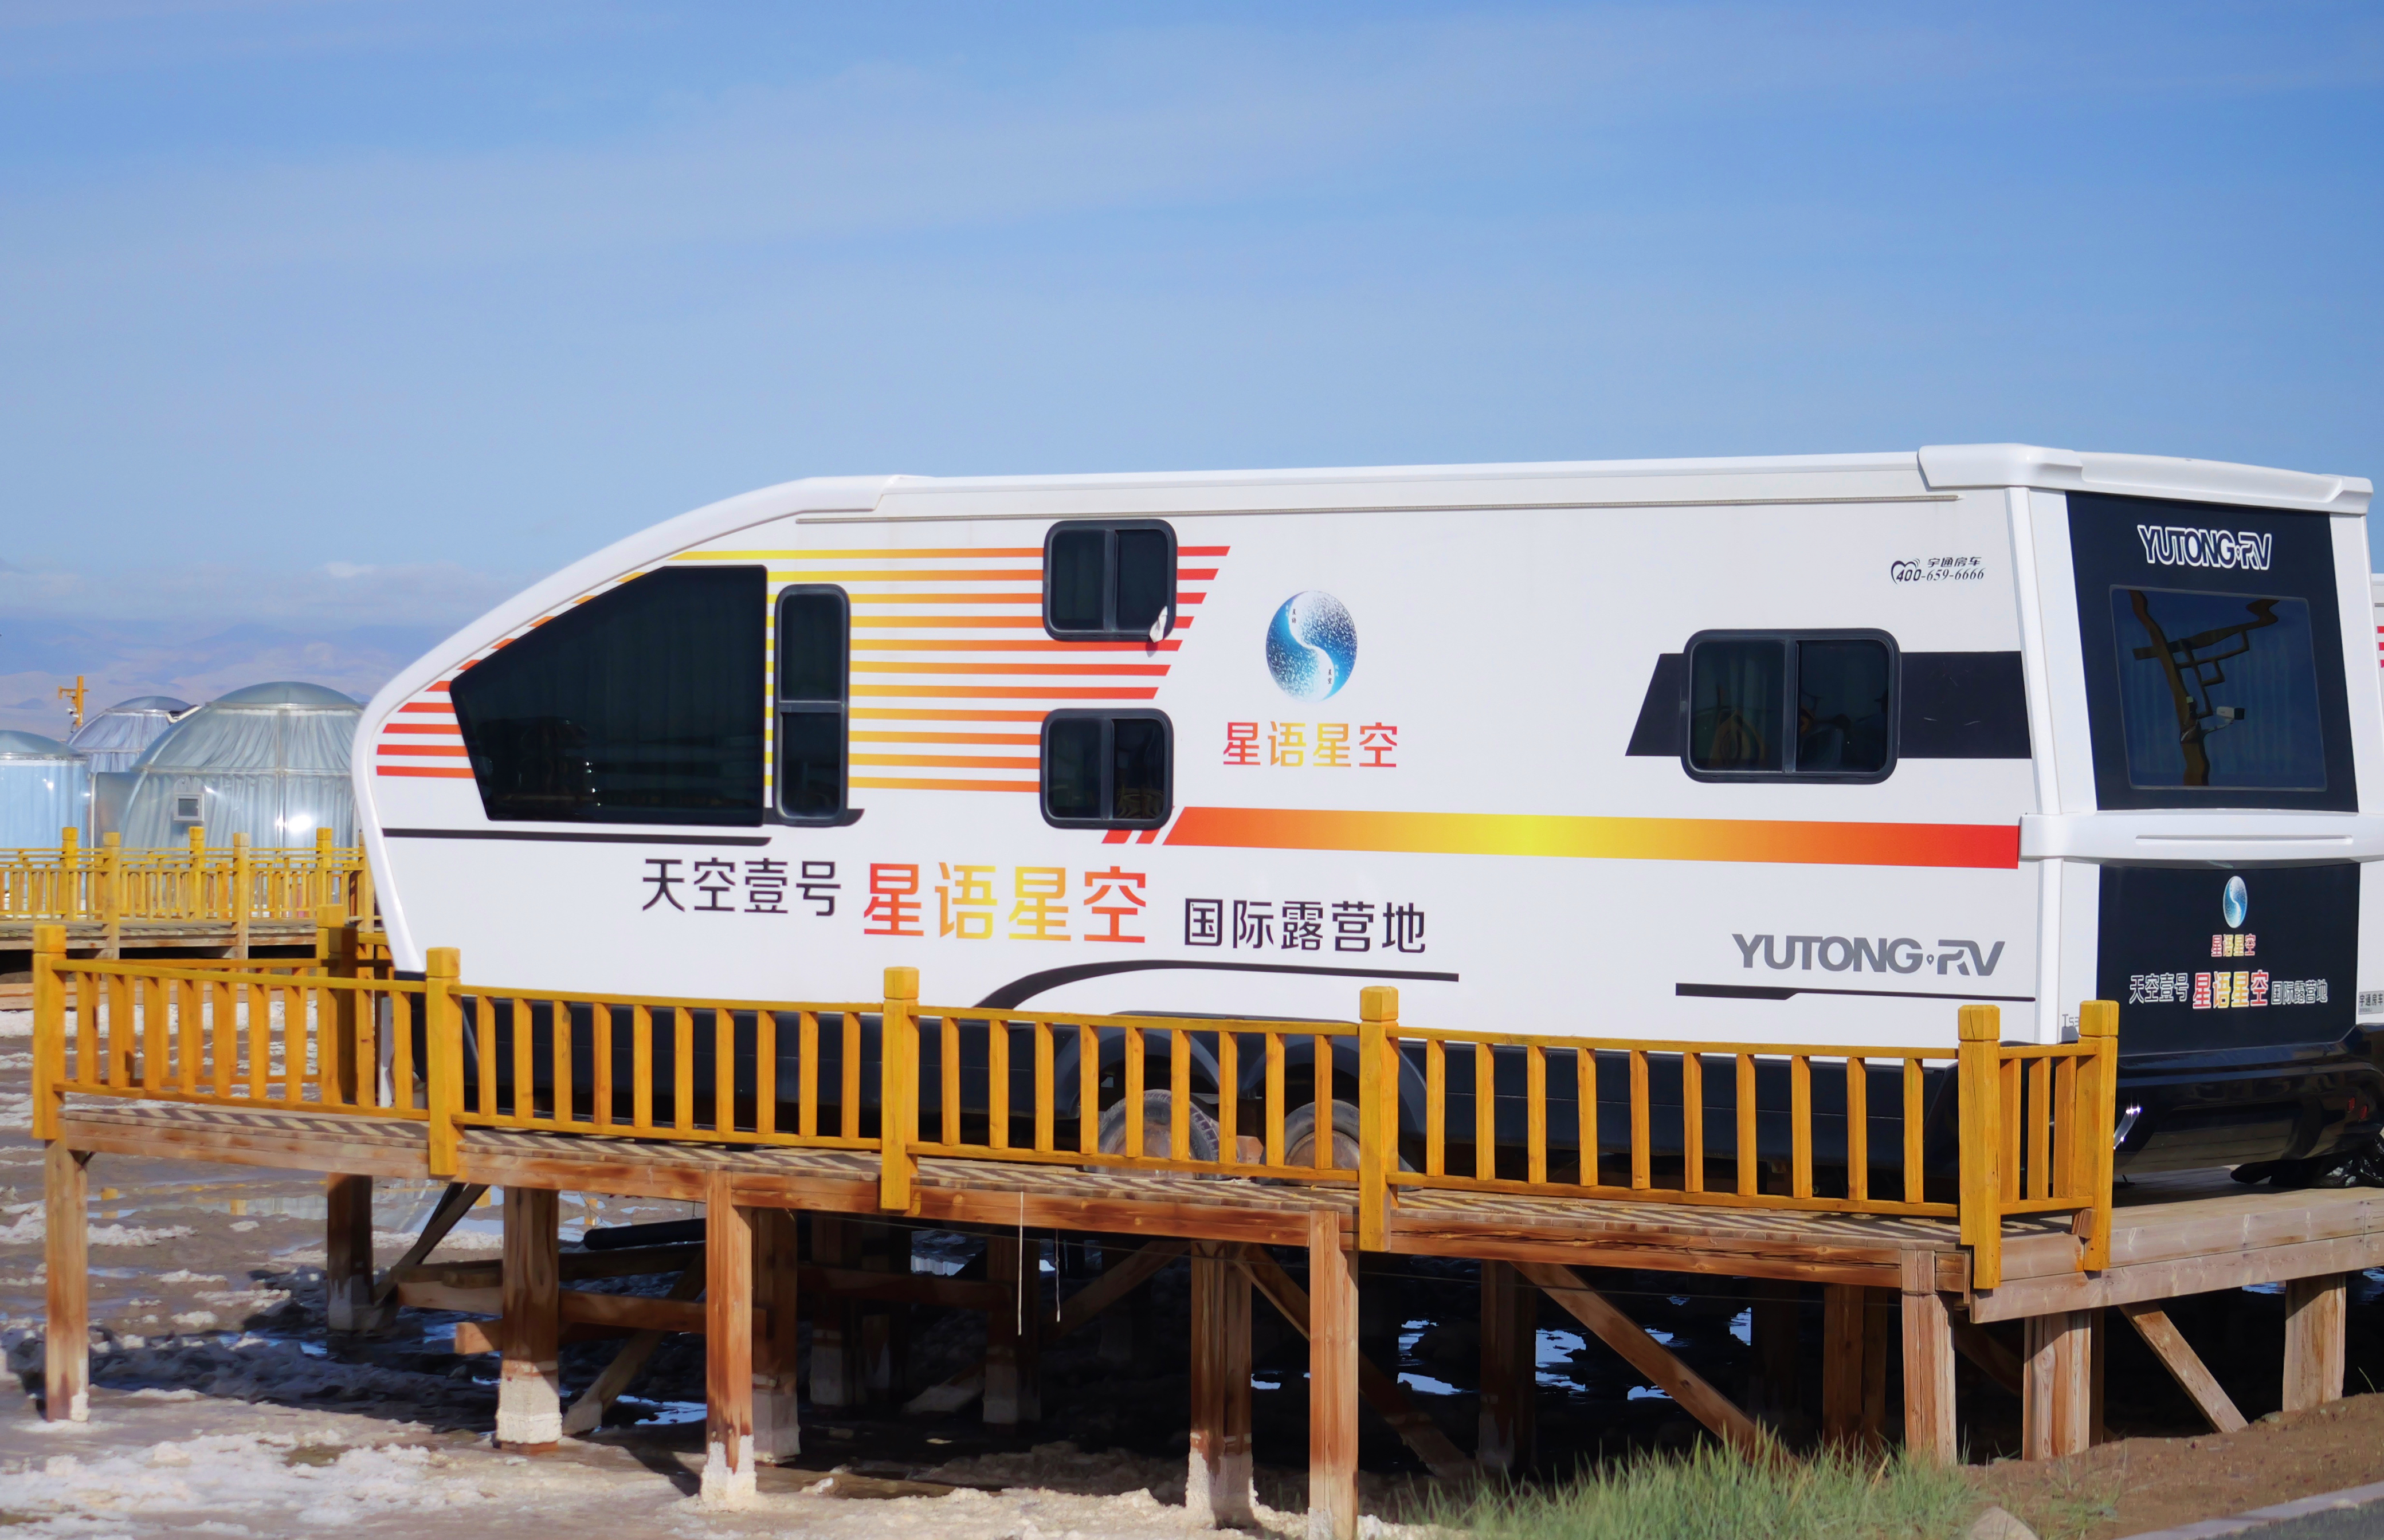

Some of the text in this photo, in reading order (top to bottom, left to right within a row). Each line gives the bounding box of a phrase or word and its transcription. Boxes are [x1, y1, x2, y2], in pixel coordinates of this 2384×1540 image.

[1896, 568, 1986, 582] 400-659-6666
[1927, 556, 1982, 567] 宇通房车
[1223, 721, 1398, 768] 星语星空
[642, 857, 1426, 953] 天空壹号 星语星空 国际露营地
[2211, 933, 2256, 957] 星语星空
[2129, 969, 2328, 1009] 天空壹号 星语星空 国际露营地
